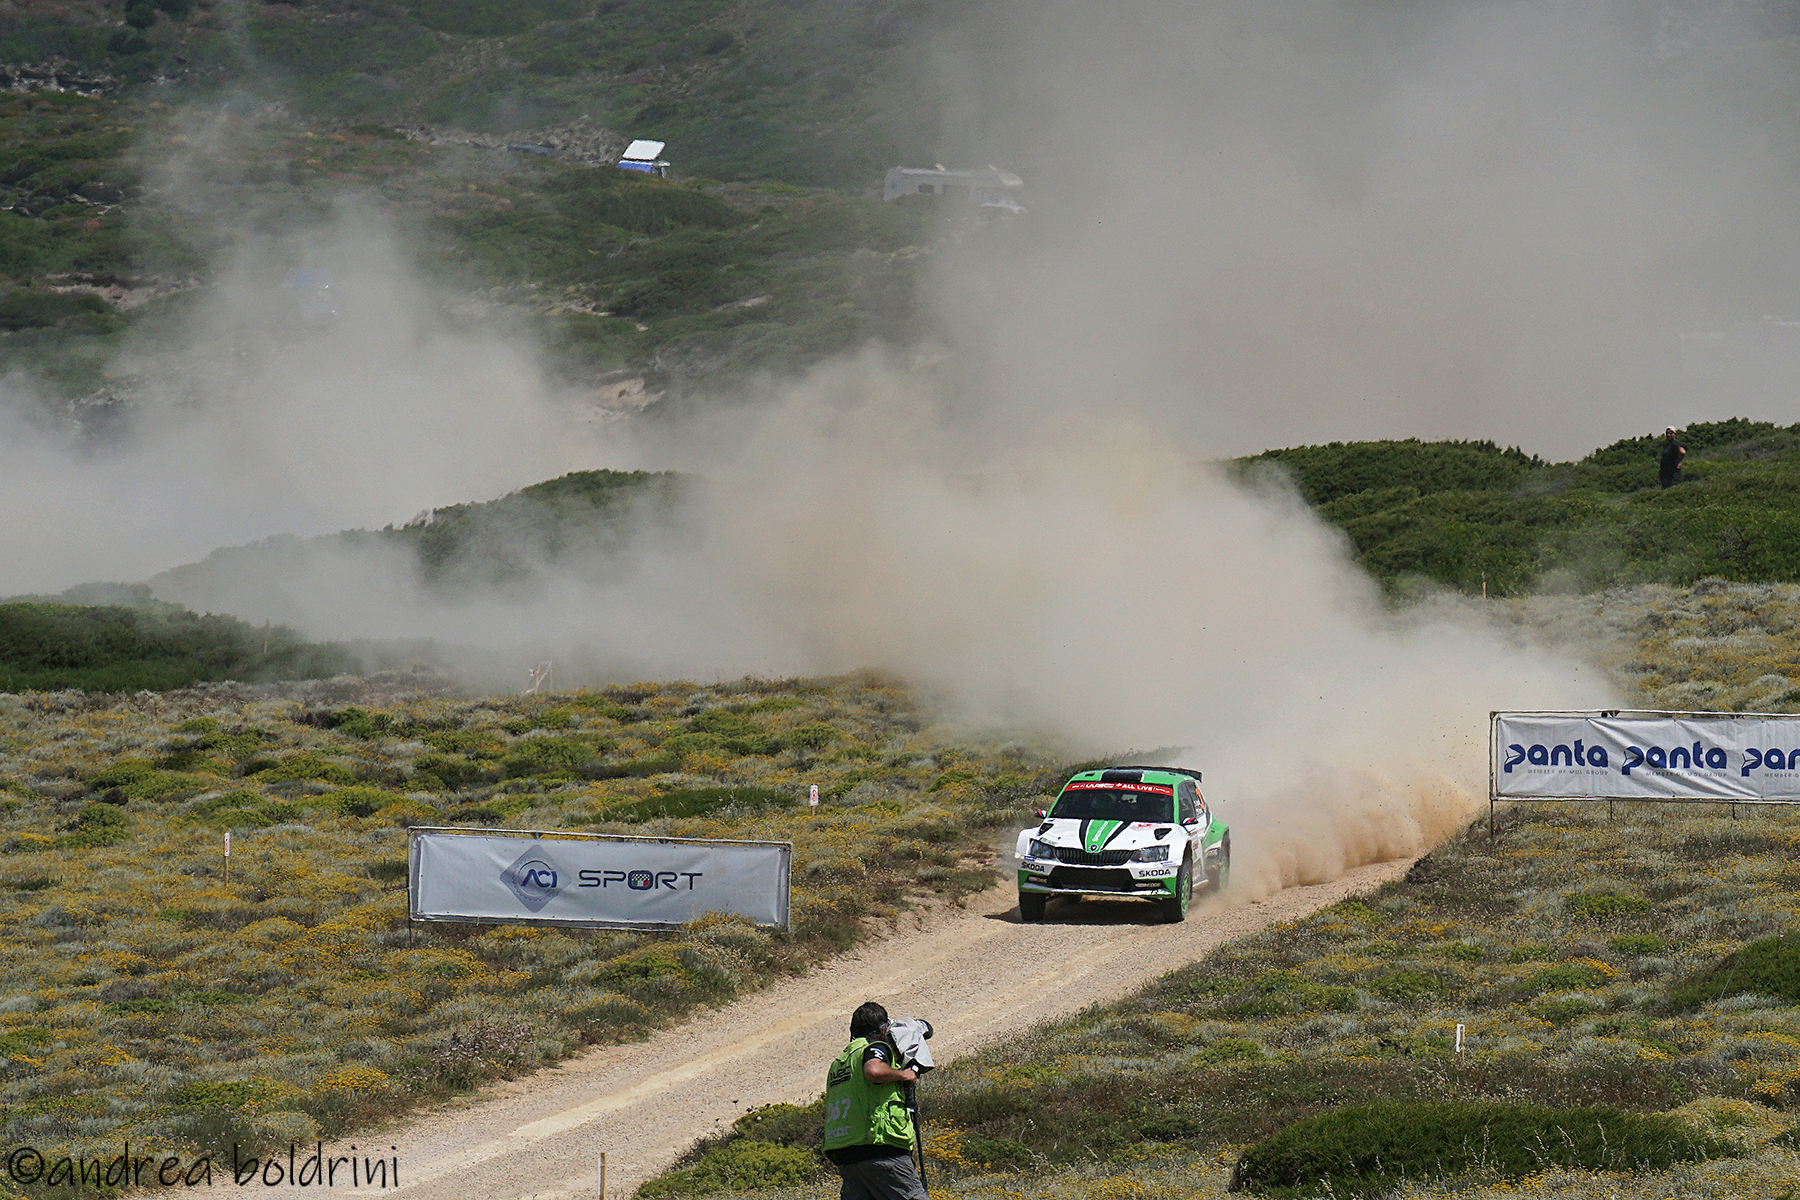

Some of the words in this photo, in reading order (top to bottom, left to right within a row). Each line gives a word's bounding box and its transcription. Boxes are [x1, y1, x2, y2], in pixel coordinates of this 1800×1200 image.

[1504, 739, 1609, 773] panta
[1621, 741, 1727, 776] panta
[520, 868, 558, 889] ACI
[578, 869, 703, 891] SPORT
